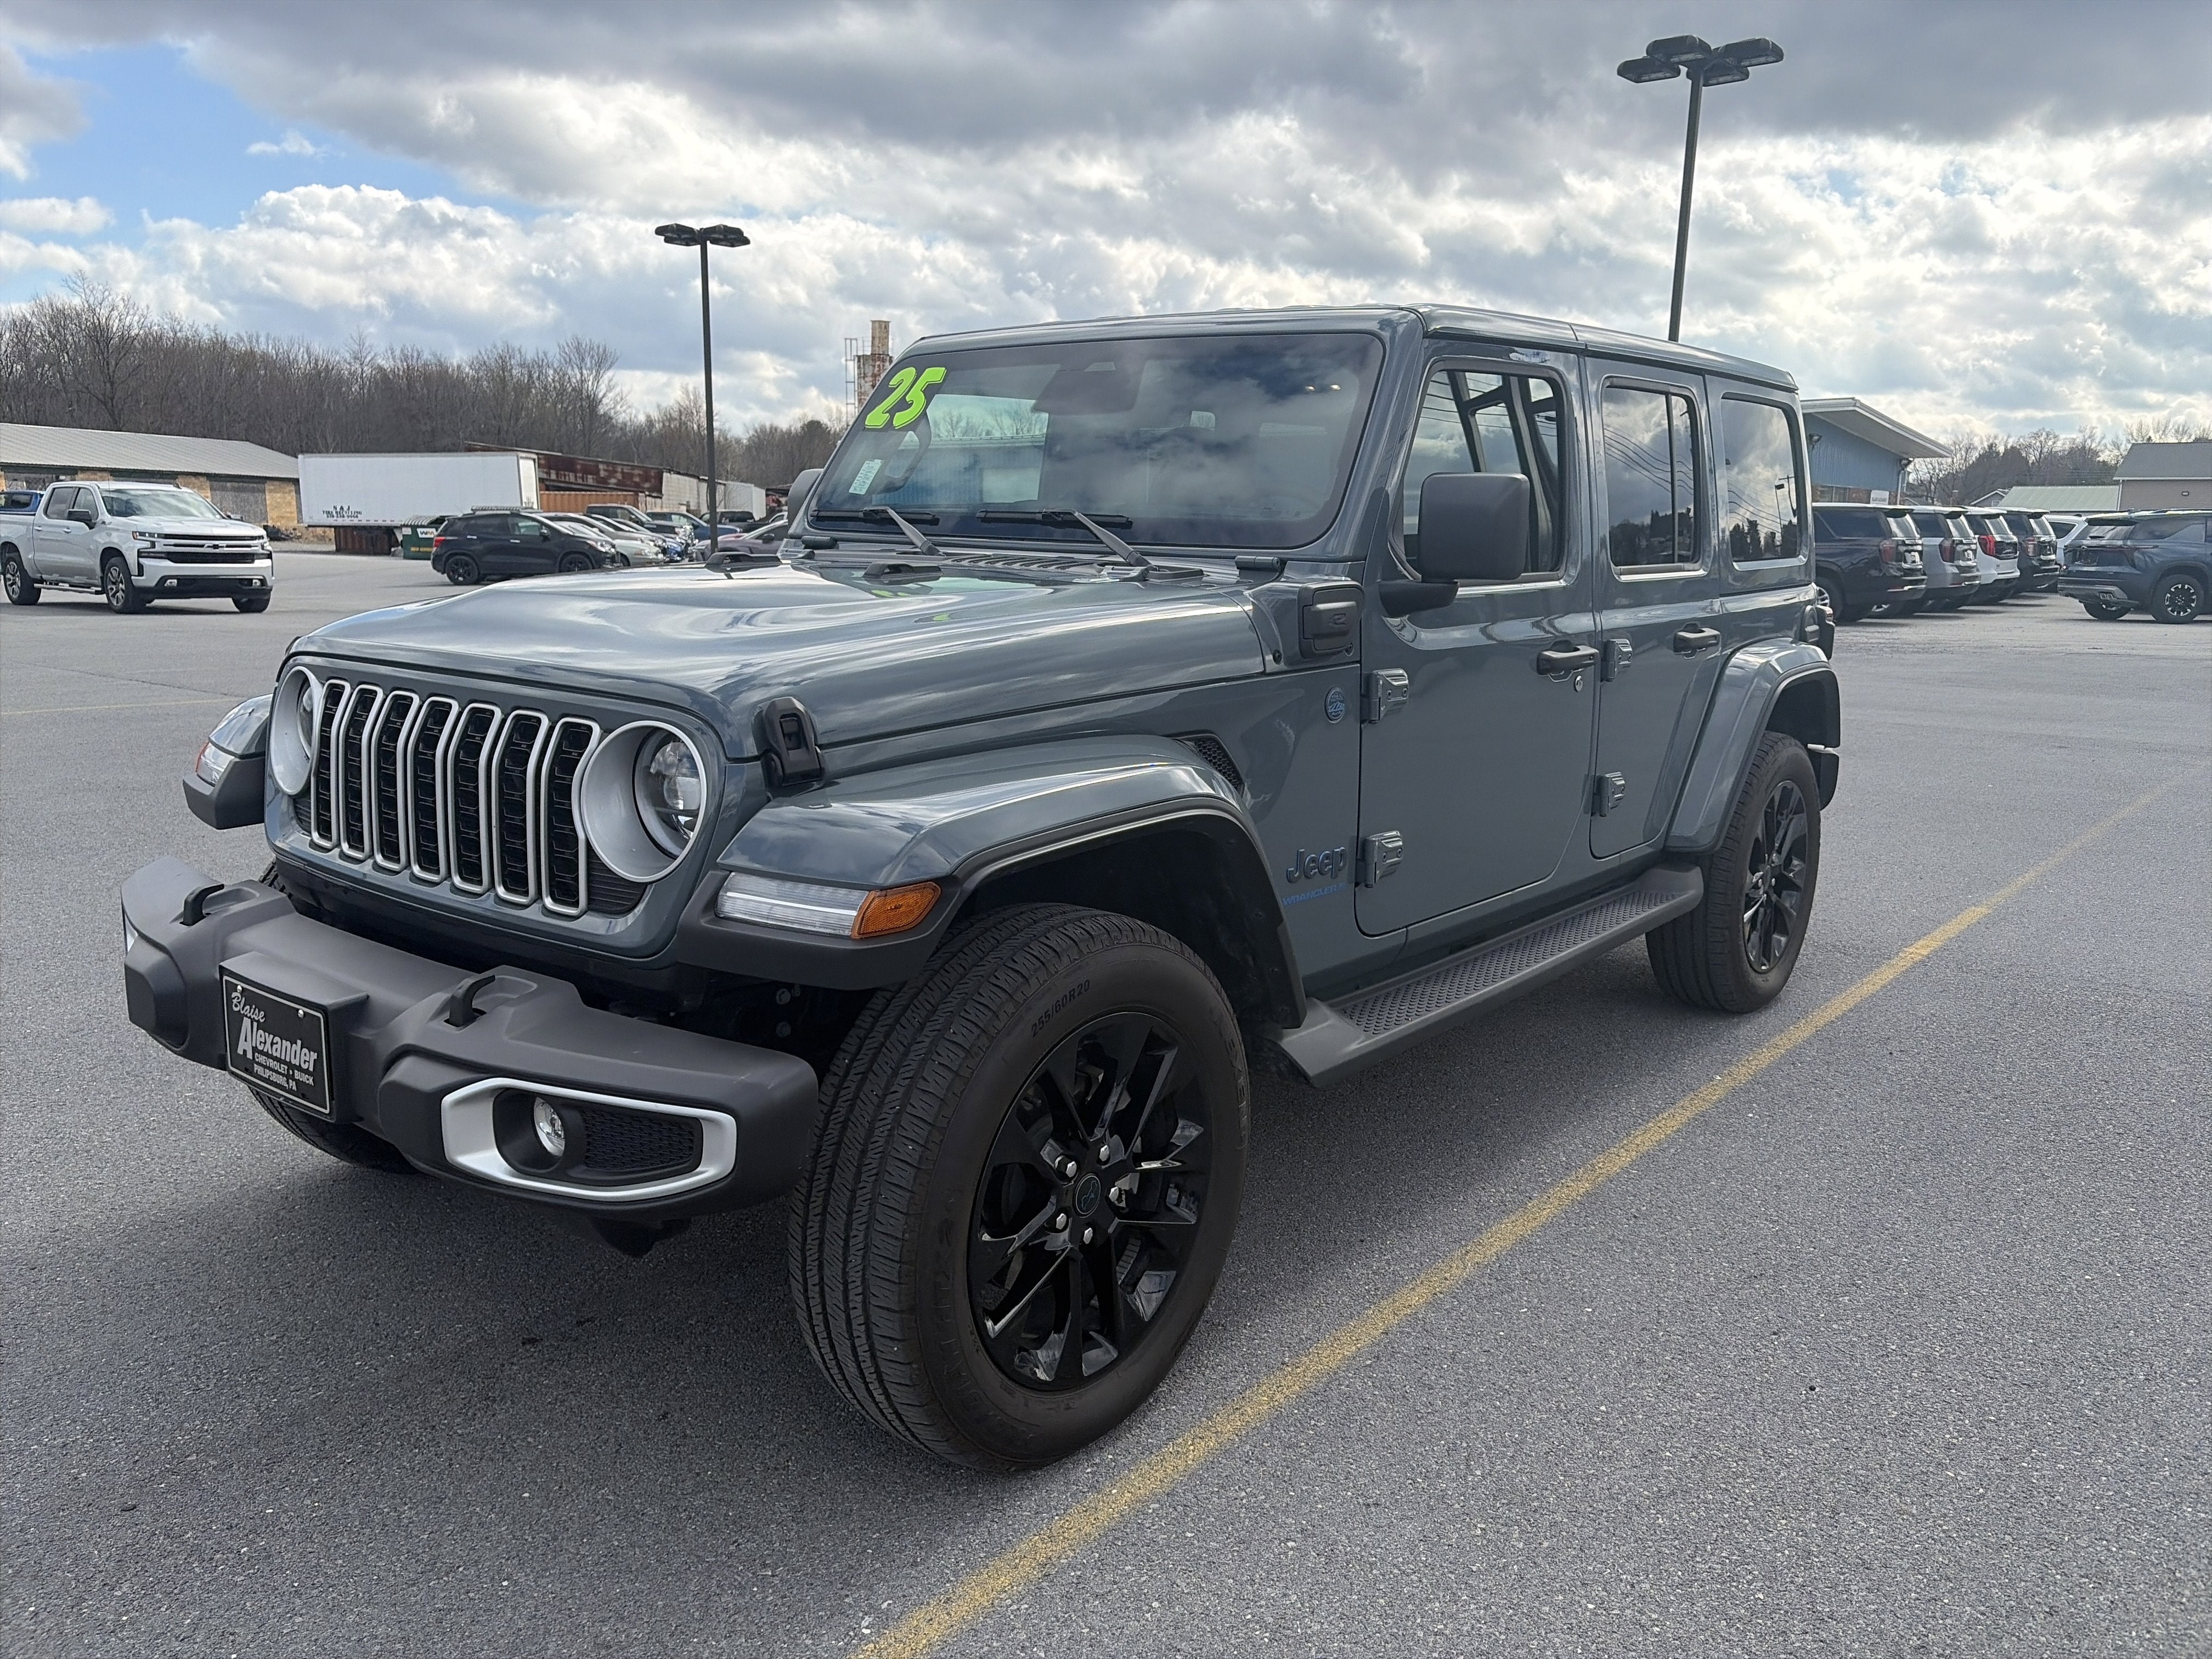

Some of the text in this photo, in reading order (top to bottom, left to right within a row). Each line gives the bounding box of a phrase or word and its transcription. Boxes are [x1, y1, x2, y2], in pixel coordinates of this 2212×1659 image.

[865, 366, 947, 430] 25
[1286, 847, 1347, 883] Jeep
[1282, 884, 1338, 905] WRANGLER
[231, 991, 266, 1023] Blaise
[1031, 979, 1090, 1038] 255/60R20
[236, 1017, 318, 1072] Alexander
[253, 1063, 297, 1092] PHILIPSBURG, PA
[255, 1052, 314, 1086] CHEVROLET BUICK
